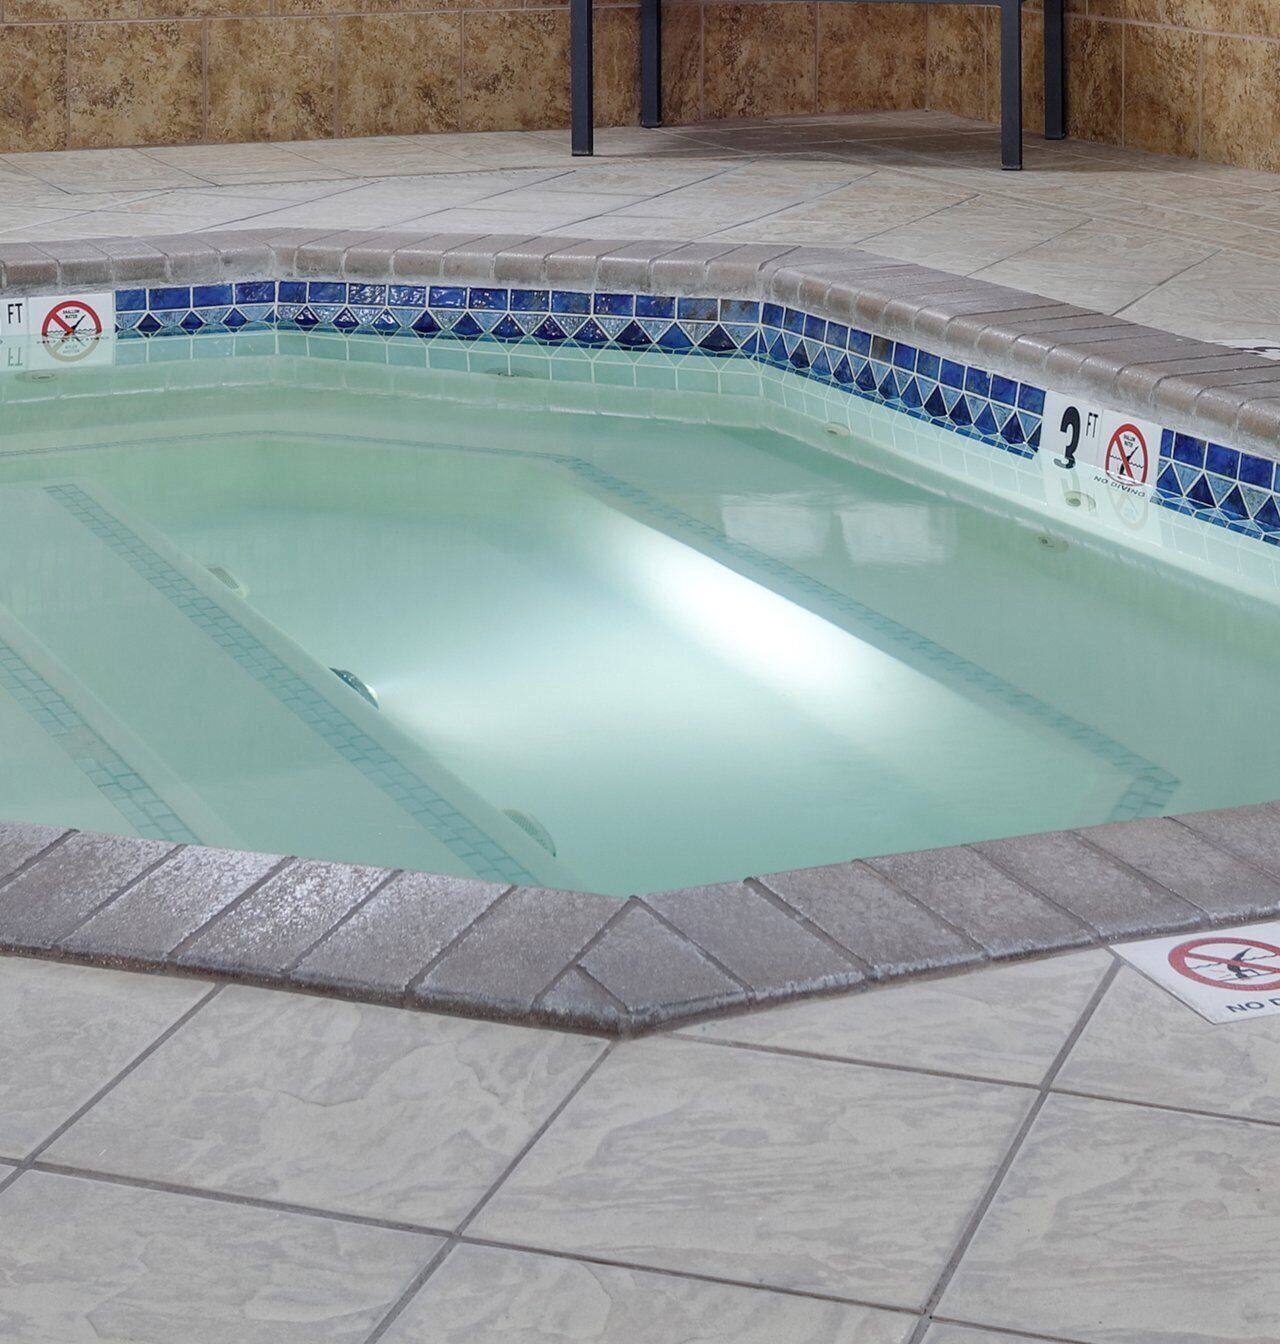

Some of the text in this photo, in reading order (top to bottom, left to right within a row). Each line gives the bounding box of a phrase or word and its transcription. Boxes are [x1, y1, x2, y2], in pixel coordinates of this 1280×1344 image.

[7, 303, 23, 324] FT
[1053, 406, 1099, 469] 3 FT
[1093, 475, 1146, 497] NO DIVING
[1226, 1001, 1265, 1013] NO
